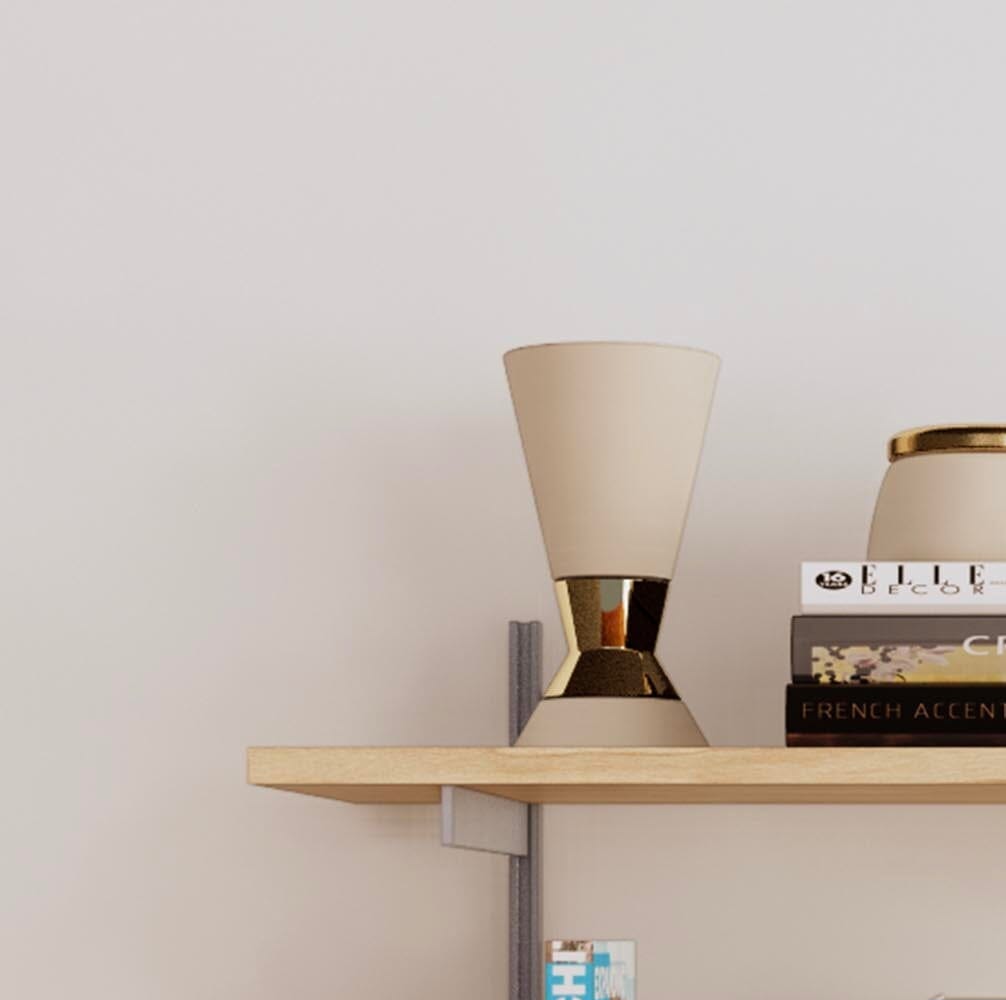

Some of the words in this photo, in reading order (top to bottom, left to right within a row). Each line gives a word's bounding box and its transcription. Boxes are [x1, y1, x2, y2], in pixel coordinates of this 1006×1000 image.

[861, 564, 985, 585] ELLE
[861, 584, 985, 595] DECOR
[801, 702, 902, 720] FRENCH
